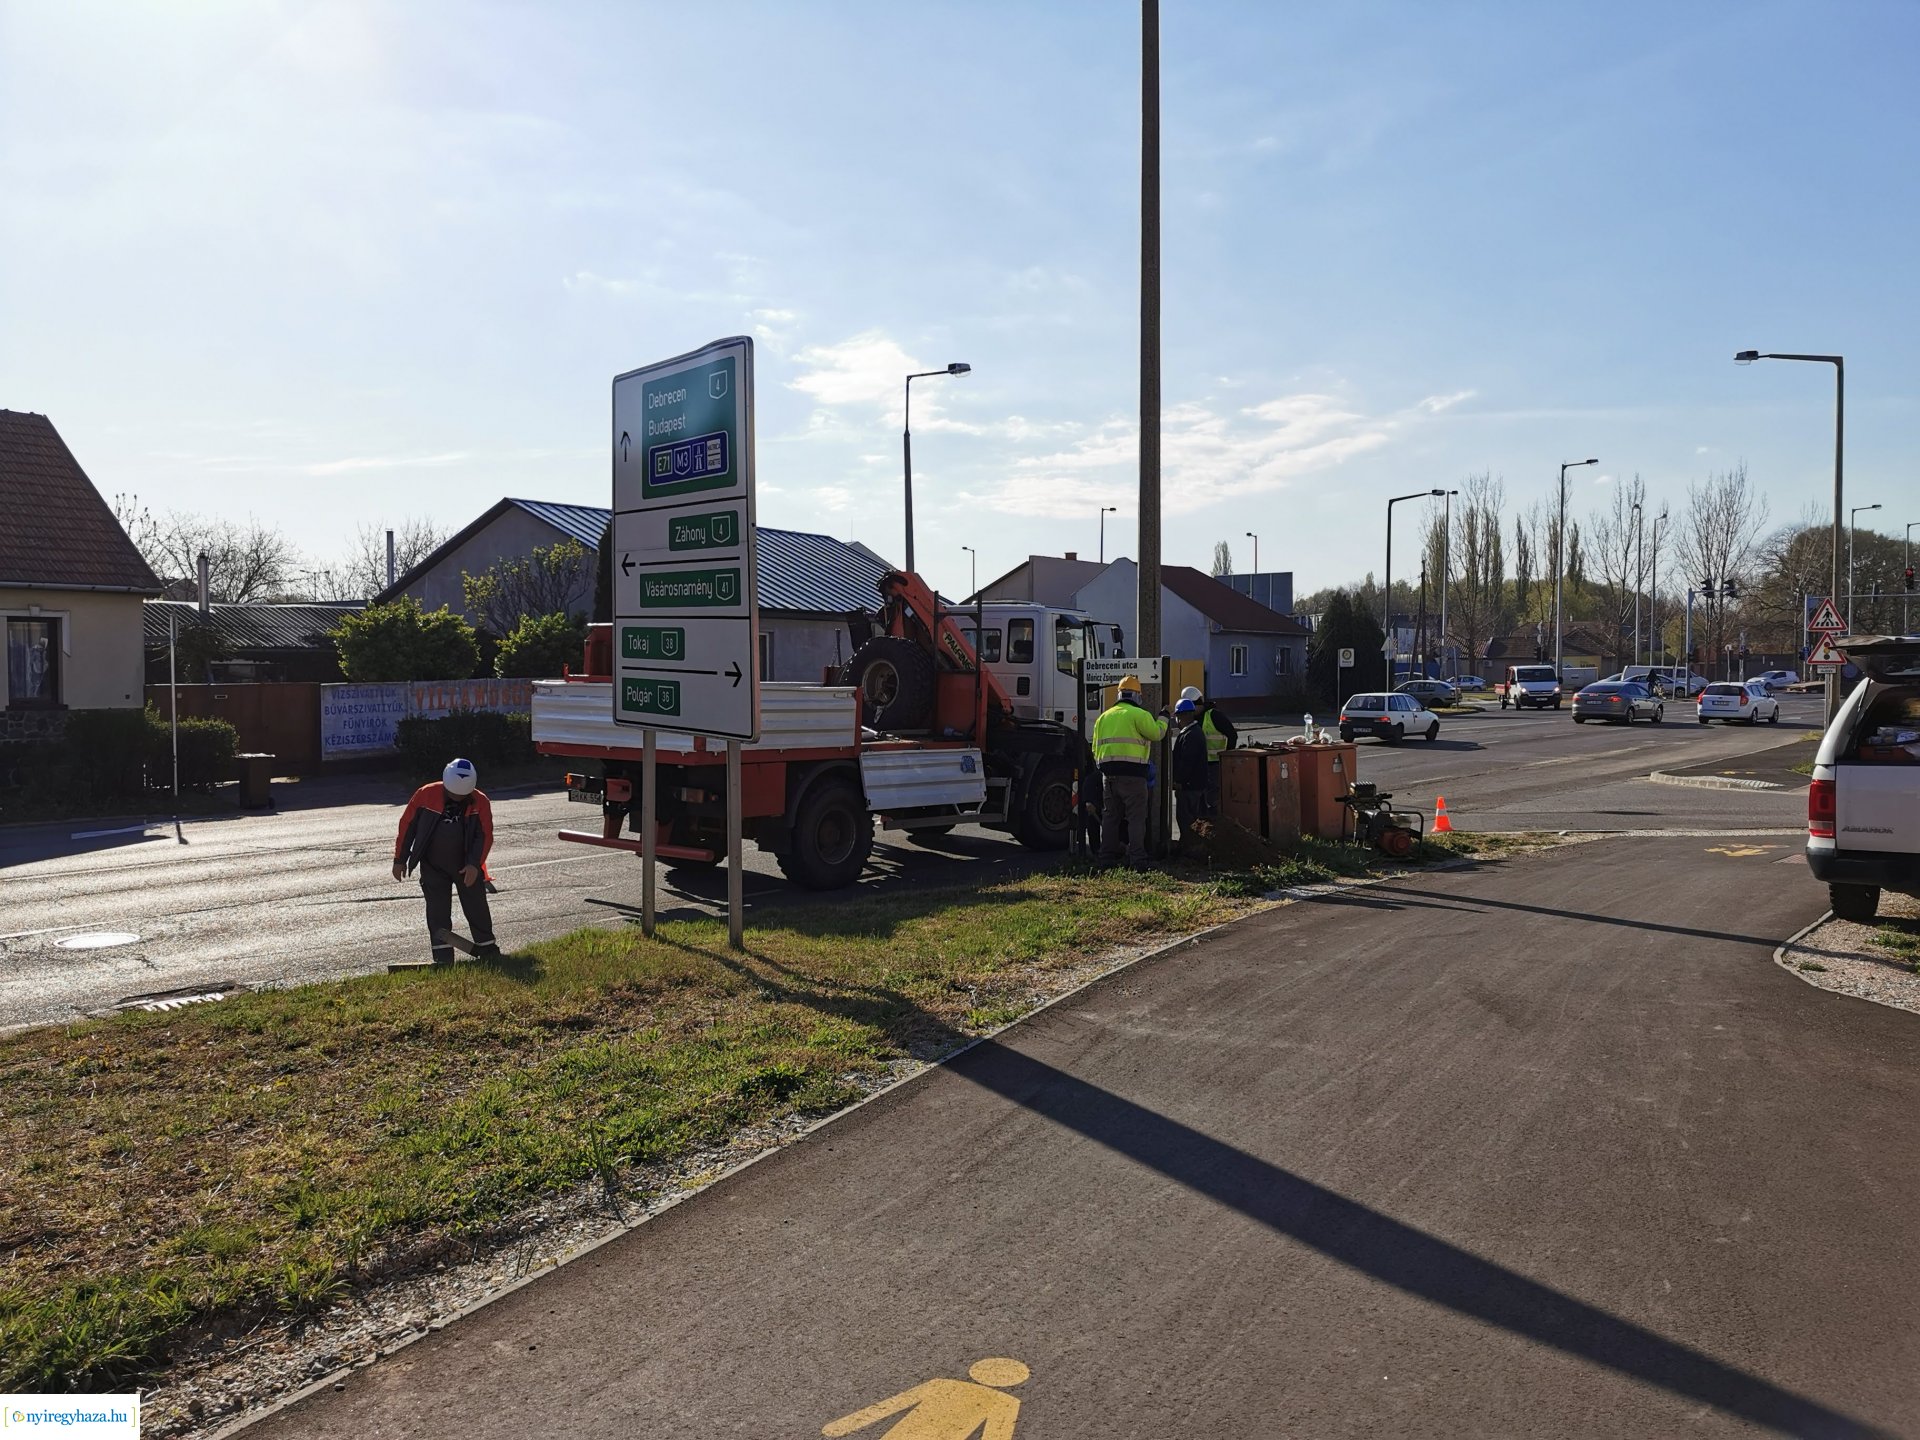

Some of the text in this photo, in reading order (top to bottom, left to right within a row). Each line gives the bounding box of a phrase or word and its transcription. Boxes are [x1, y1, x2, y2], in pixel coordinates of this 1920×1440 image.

[715, 378, 721, 391] 4
[648, 388, 687, 409] Debrecen
[648, 412, 686, 437] Budapest
[657, 454, 670, 472] E71
[676, 451, 689, 468] M3
[675, 523, 723, 544] Záhony 4
[645, 579, 729, 599] Vásárosnamény 41
[628, 634, 673, 654] Tokaj 38
[1086, 660, 1138, 670] Debreceni utca
[626, 686, 670, 706] Polgár 36
